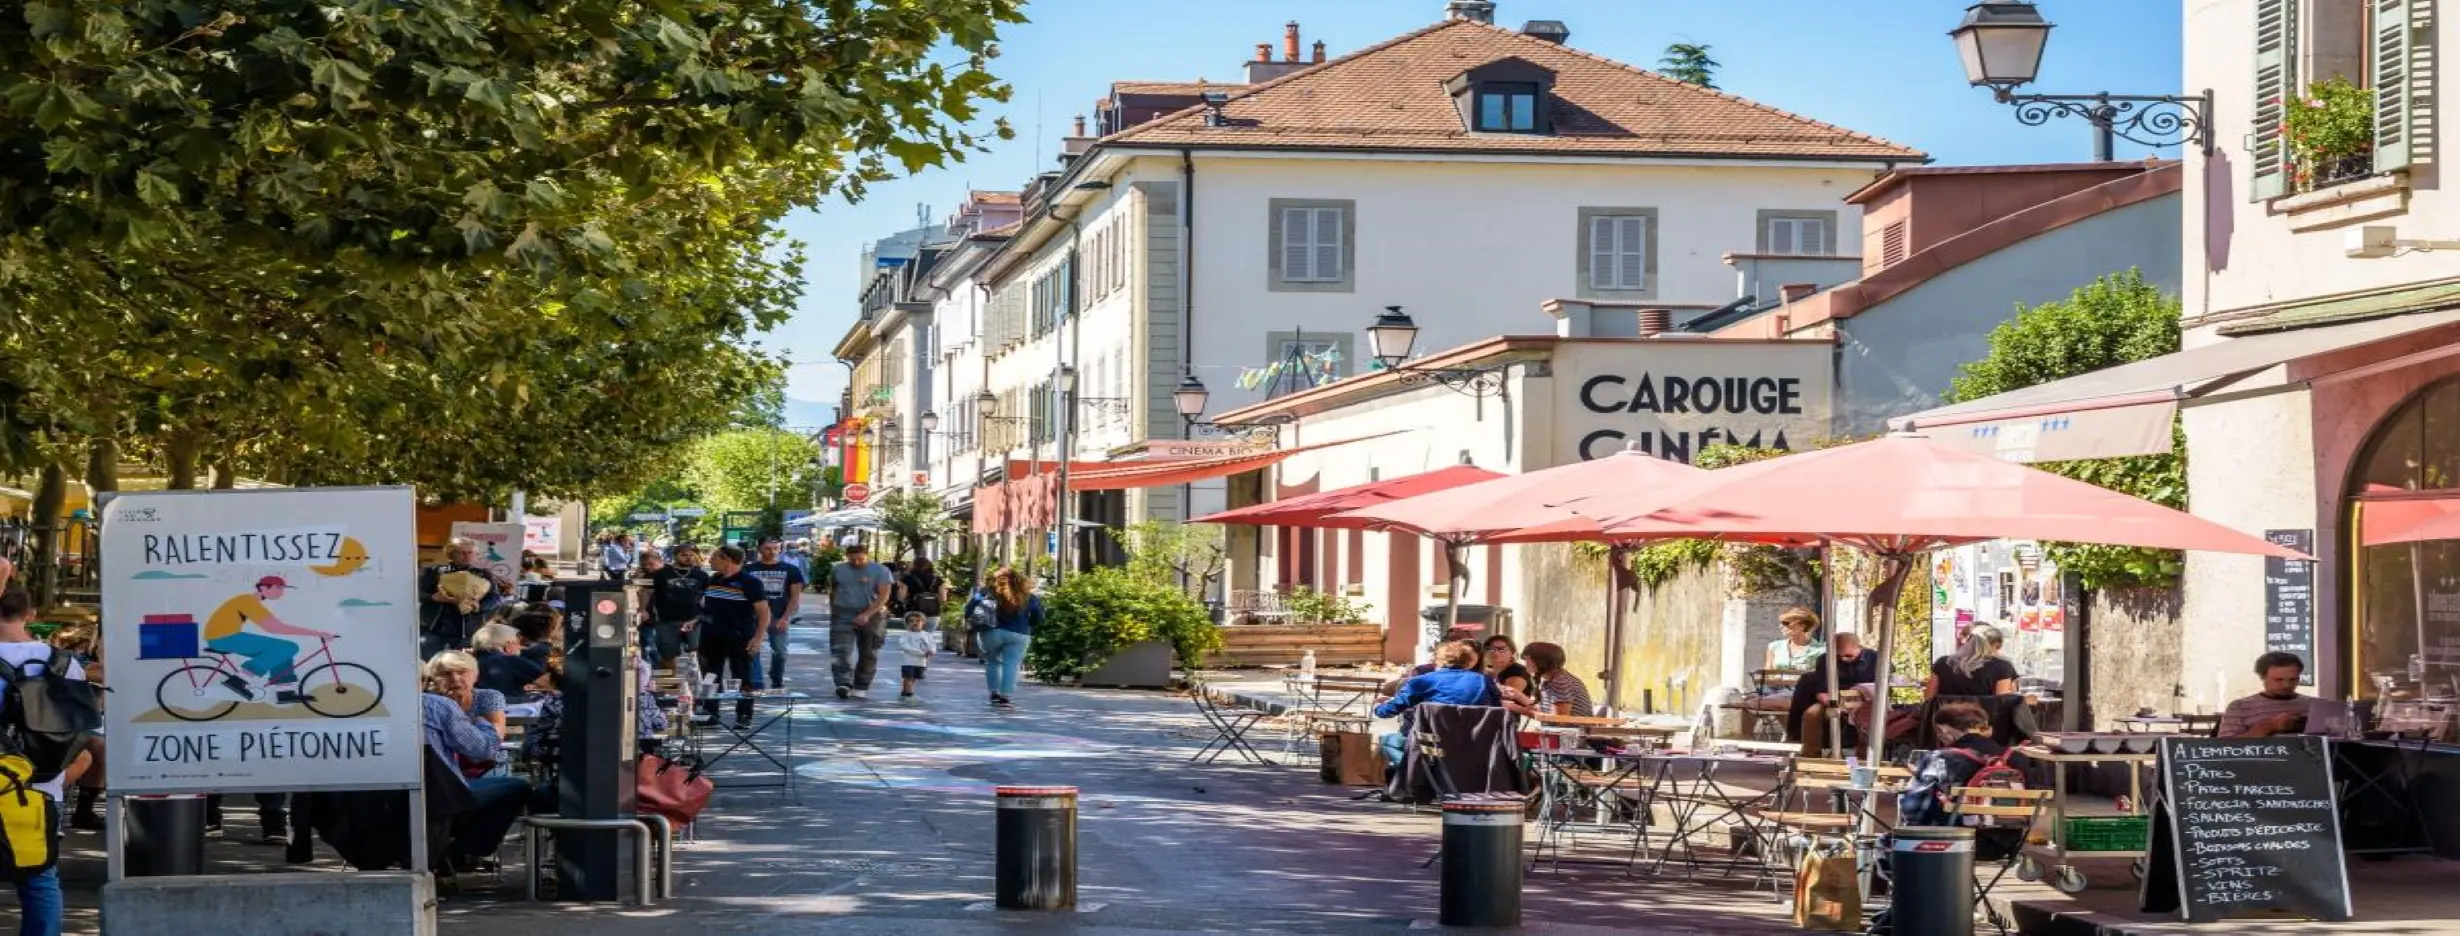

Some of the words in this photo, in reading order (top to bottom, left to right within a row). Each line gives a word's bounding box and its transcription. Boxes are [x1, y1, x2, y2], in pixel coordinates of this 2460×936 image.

[1579, 371, 1802, 414] CAROUGE
[1169, 446, 1224, 456] CINEMA
[144, 734, 220, 763] ZONE
[240, 726, 385, 762] PIÉTONNE
[2192, 745, 2290, 759] L'EMPORTER
